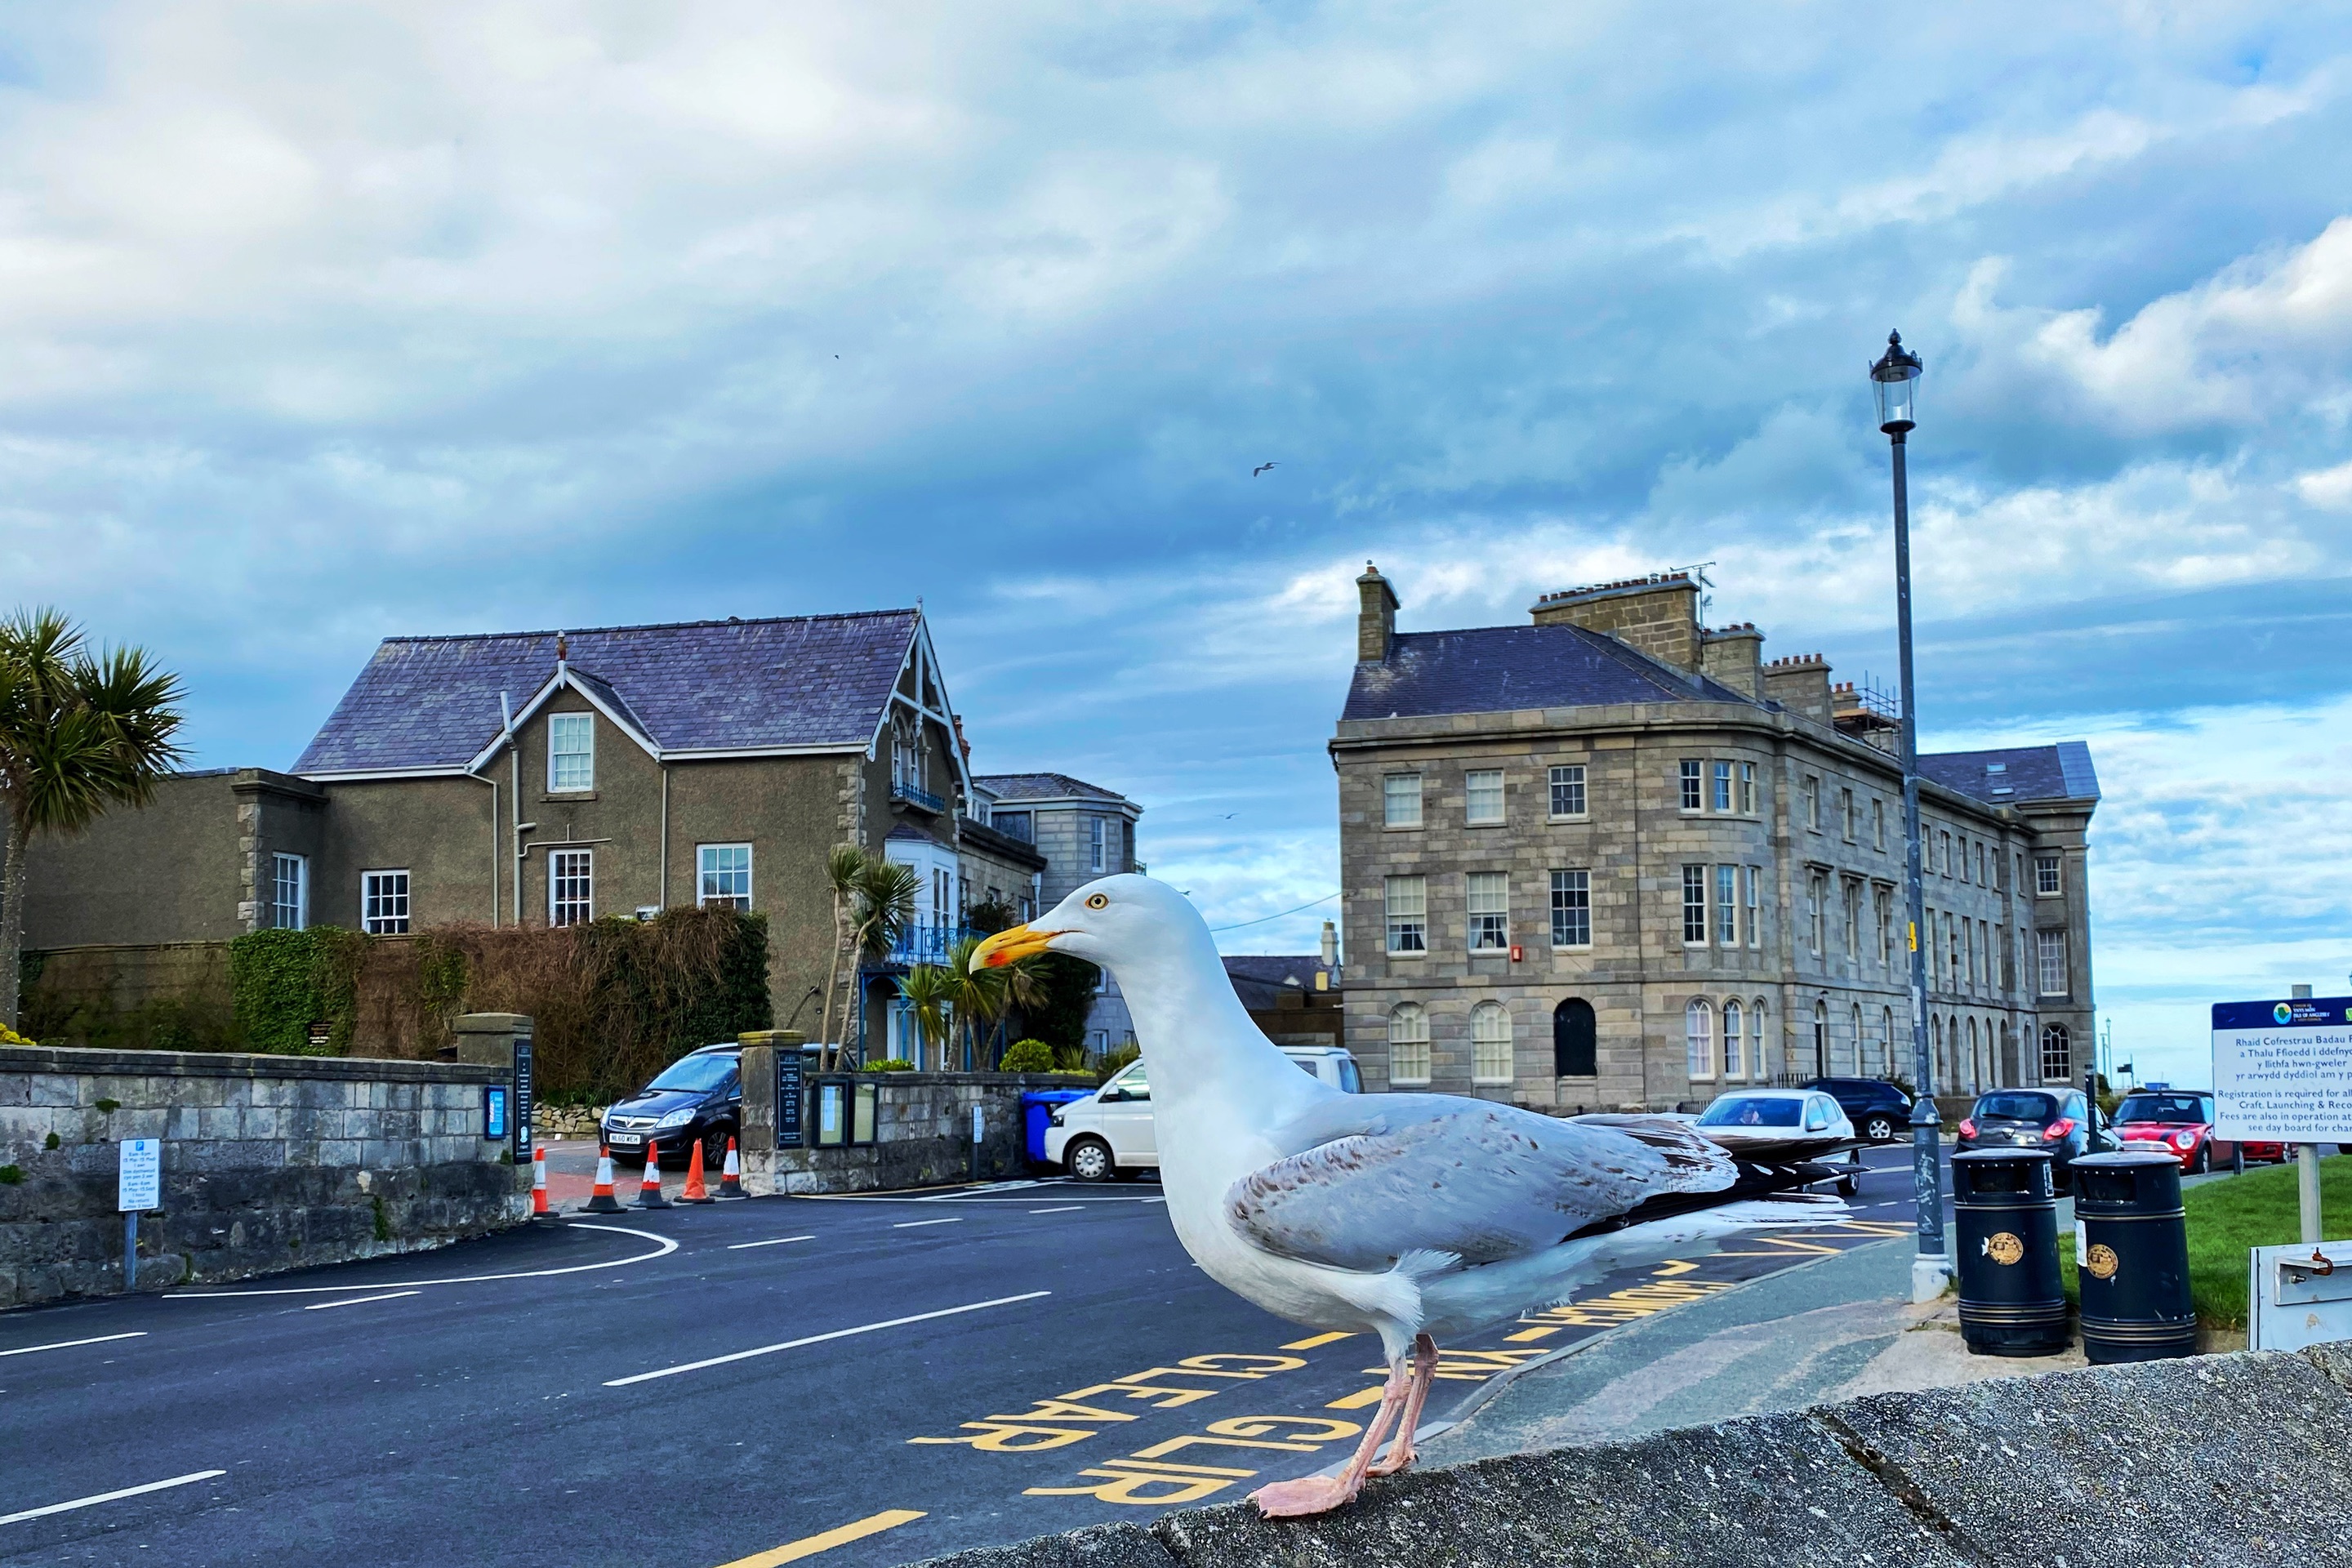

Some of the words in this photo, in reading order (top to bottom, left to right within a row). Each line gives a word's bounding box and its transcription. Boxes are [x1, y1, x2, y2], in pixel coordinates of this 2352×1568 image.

[2236, 1038, 2260, 1046] Rhaid
[2264, 1037, 2312, 1045] Cofrestrau
[2316, 1035, 2345, 1044] Badau
[2248, 1049, 2273, 1057] Thalu
[2276, 1048, 2310, 1057] Ffioedd
[2313, 1047, 2316, 1056] i
[2257, 1062, 2262, 1070] y
[2292, 1059, 2347, 1069] hwn-gweler
[2236, 1073, 2245, 1082] yr
[2248, 1071, 2280, 1081] arwydd
[2284, 1070, 2317, 1080] dyddiol
[2339, 1071, 2344, 1080] y
[2218, 1090, 2272, 1100] Registration
[2275, 1090, 2282, 1098] is
[2285, 1089, 2323, 1099] required
[2327, 1089, 2339, 1097] for
[2343, 1089, 2352, 1097] all
[2267, 1101, 2314, 1111] Launching
[2318, 1100, 2325, 1109] &
[2220, 1112, 2239, 1120] Fees
[2260, 1112, 2277, 1120] also
[2281, 1112, 2289, 1120] in
[2292, 1112, 2338, 1122] operation
[2266, 1124, 2281, 1133] day
[2285, 1123, 2312, 1132] board
[2315, 1123, 2328, 1131] for
[906, 1352, 1308, 1452] CLEAR
[1021, 1414, 1363, 1504] GLIR
